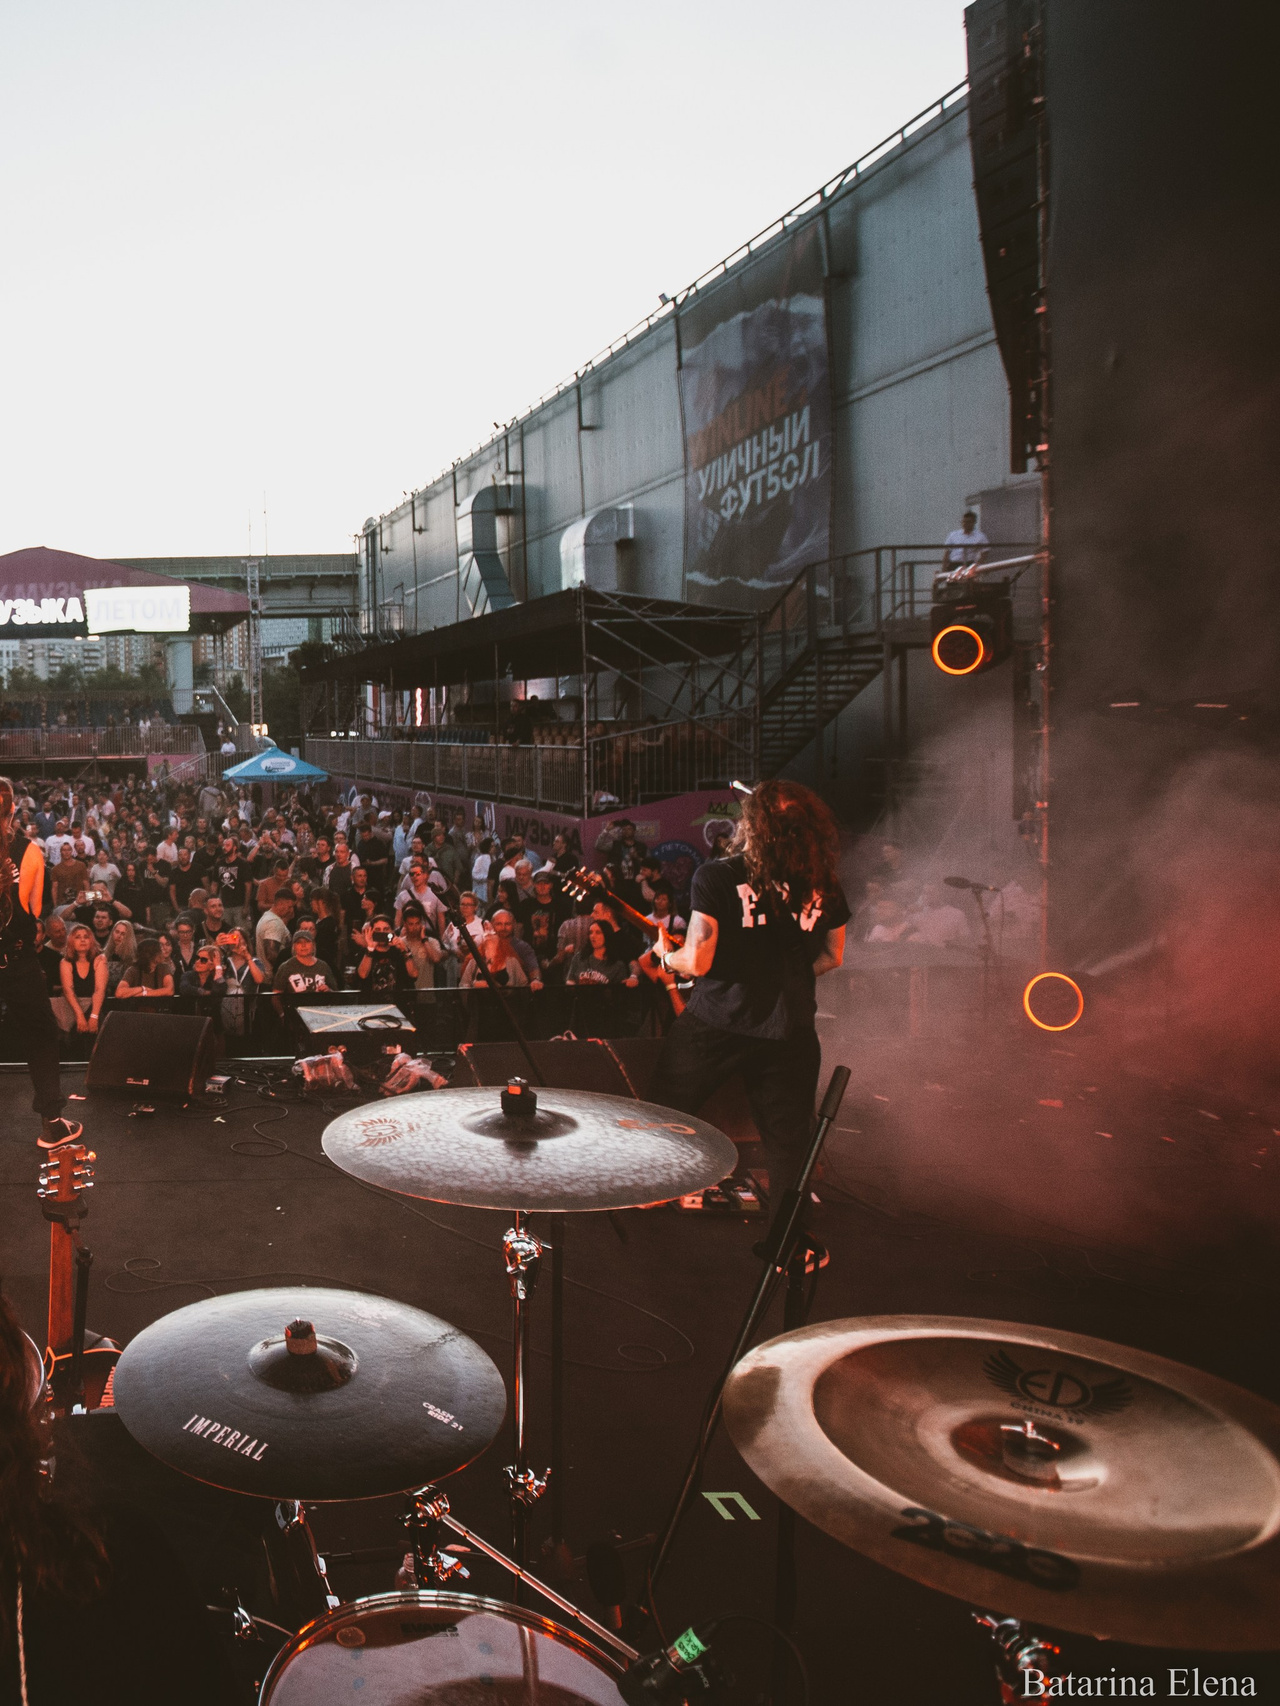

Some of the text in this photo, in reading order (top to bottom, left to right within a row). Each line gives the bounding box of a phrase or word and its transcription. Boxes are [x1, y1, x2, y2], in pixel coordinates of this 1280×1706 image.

[720, 440, 821, 521] ФУТБОЛ
[422, 1402, 455, 1420] CRASH
[427, 1410, 464, 1431] RIDE 21
[182, 1414, 269, 1461] IMPERIAL
